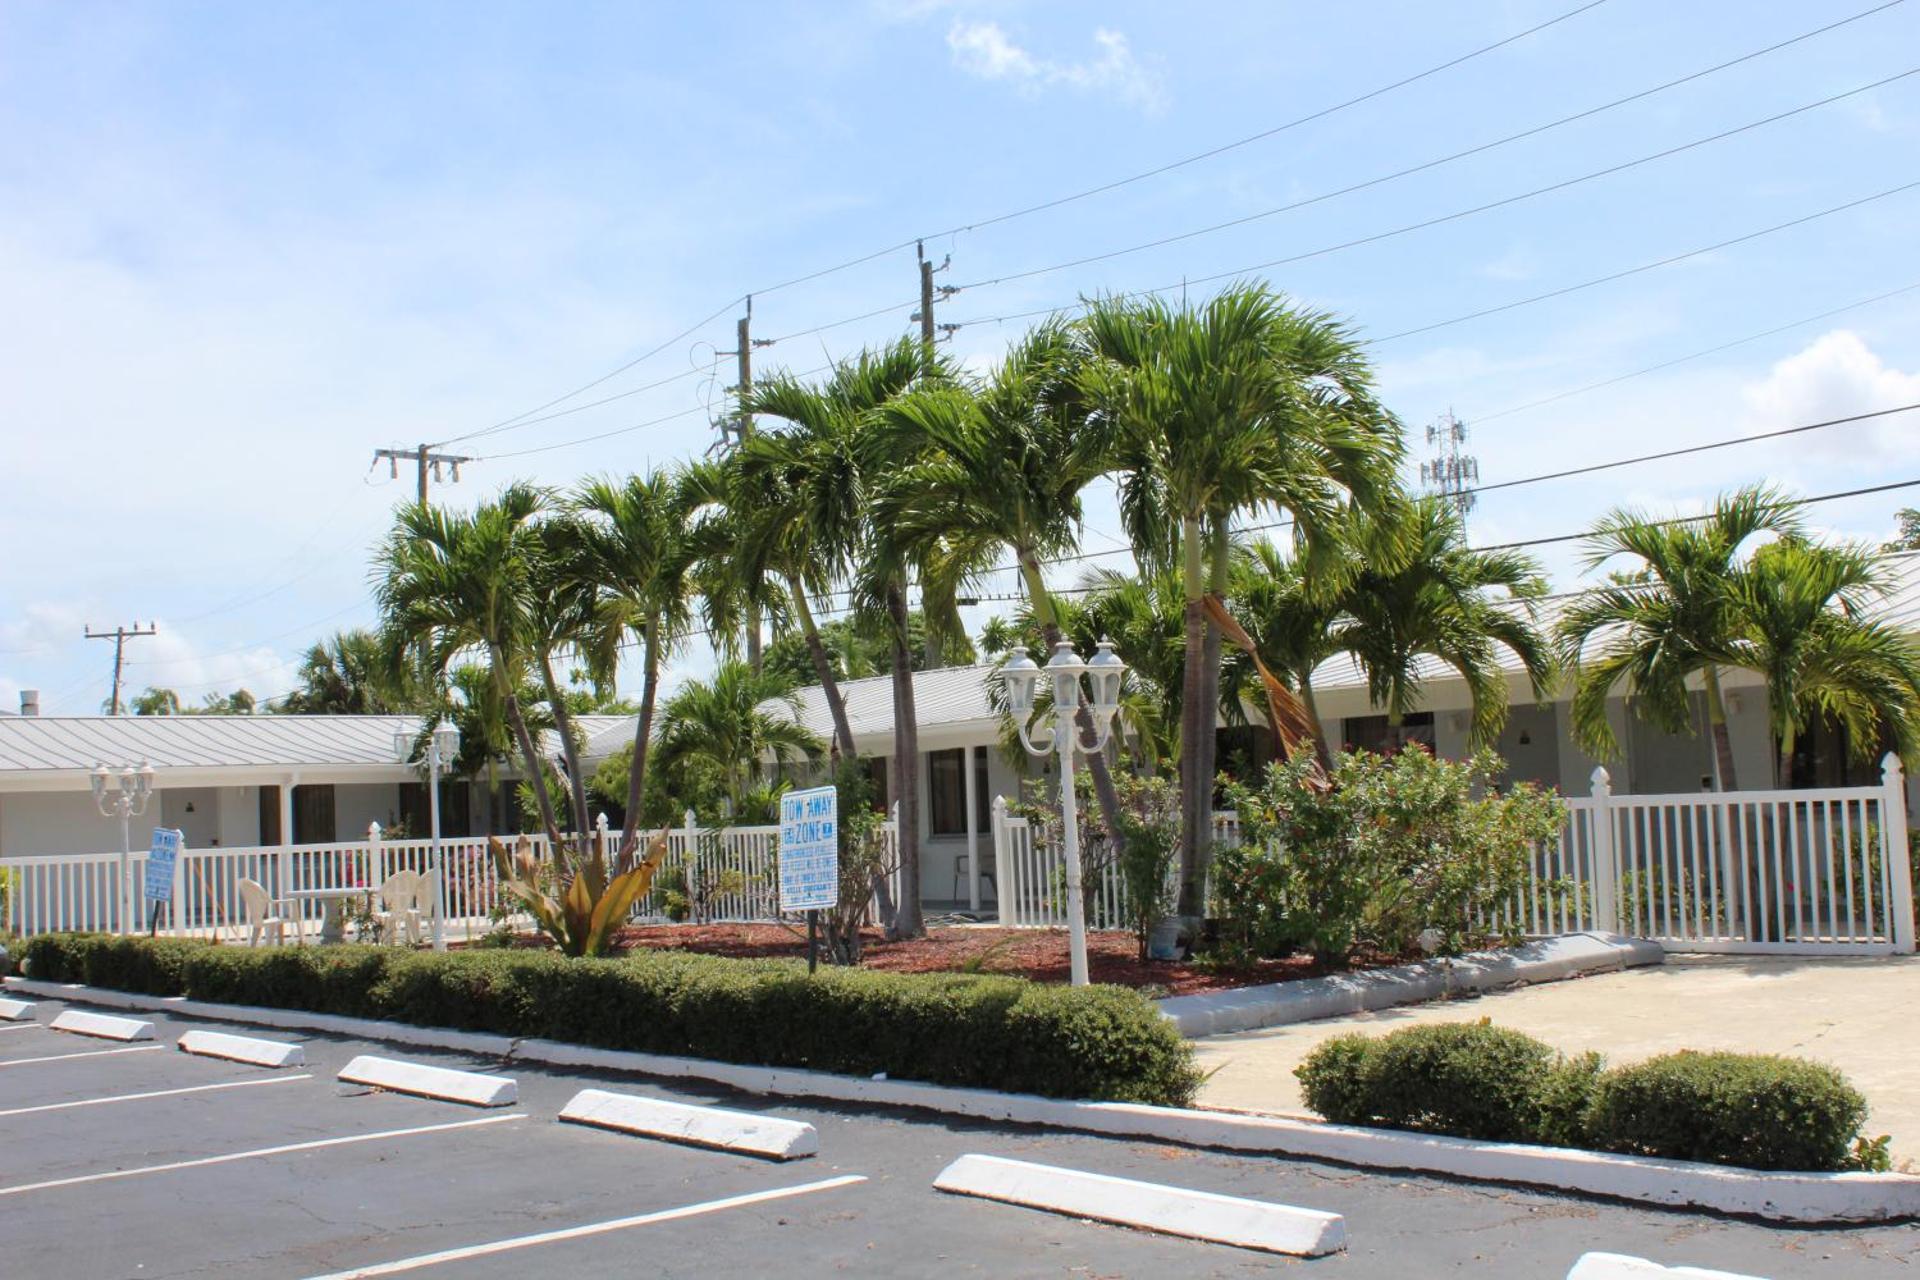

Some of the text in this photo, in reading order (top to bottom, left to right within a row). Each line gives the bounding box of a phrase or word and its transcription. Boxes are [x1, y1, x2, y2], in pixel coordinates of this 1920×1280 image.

[784, 795, 833, 821] TOW AWAY
[795, 821, 821, 844] ZONE
